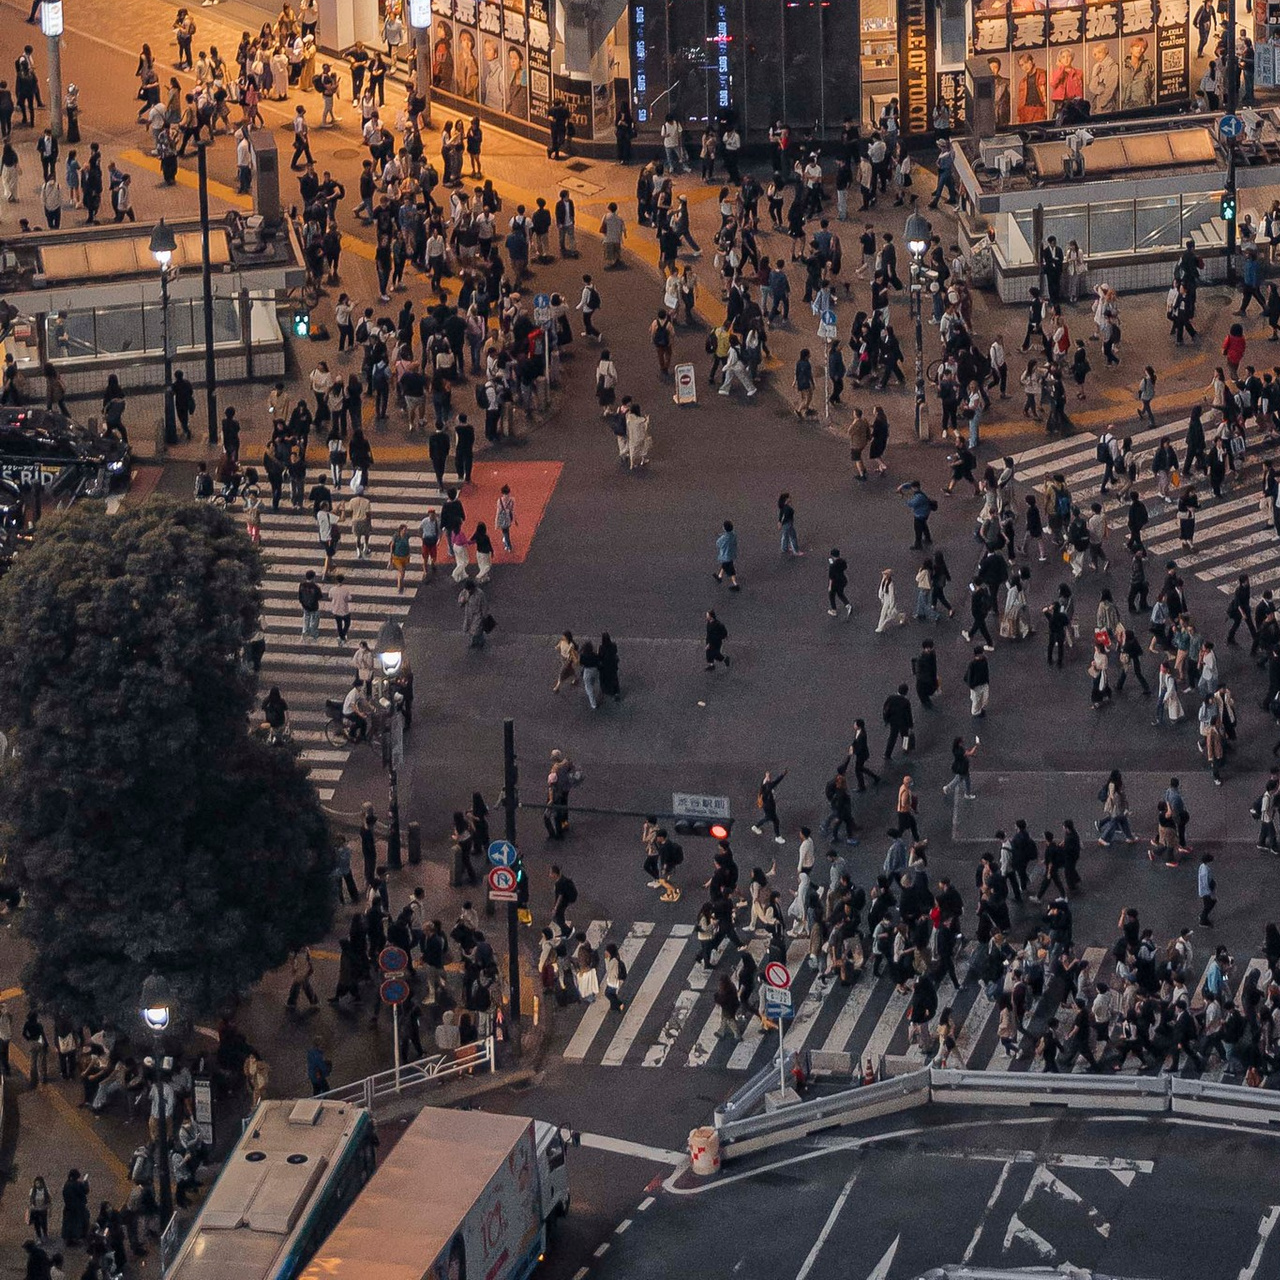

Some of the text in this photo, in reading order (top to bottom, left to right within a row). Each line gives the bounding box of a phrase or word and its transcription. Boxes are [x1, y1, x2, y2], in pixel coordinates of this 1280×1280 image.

[1159, 39, 1186, 47] CREATORS
[908, 49, 927, 74] OF
[909, 78, 928, 133] TOKYO
